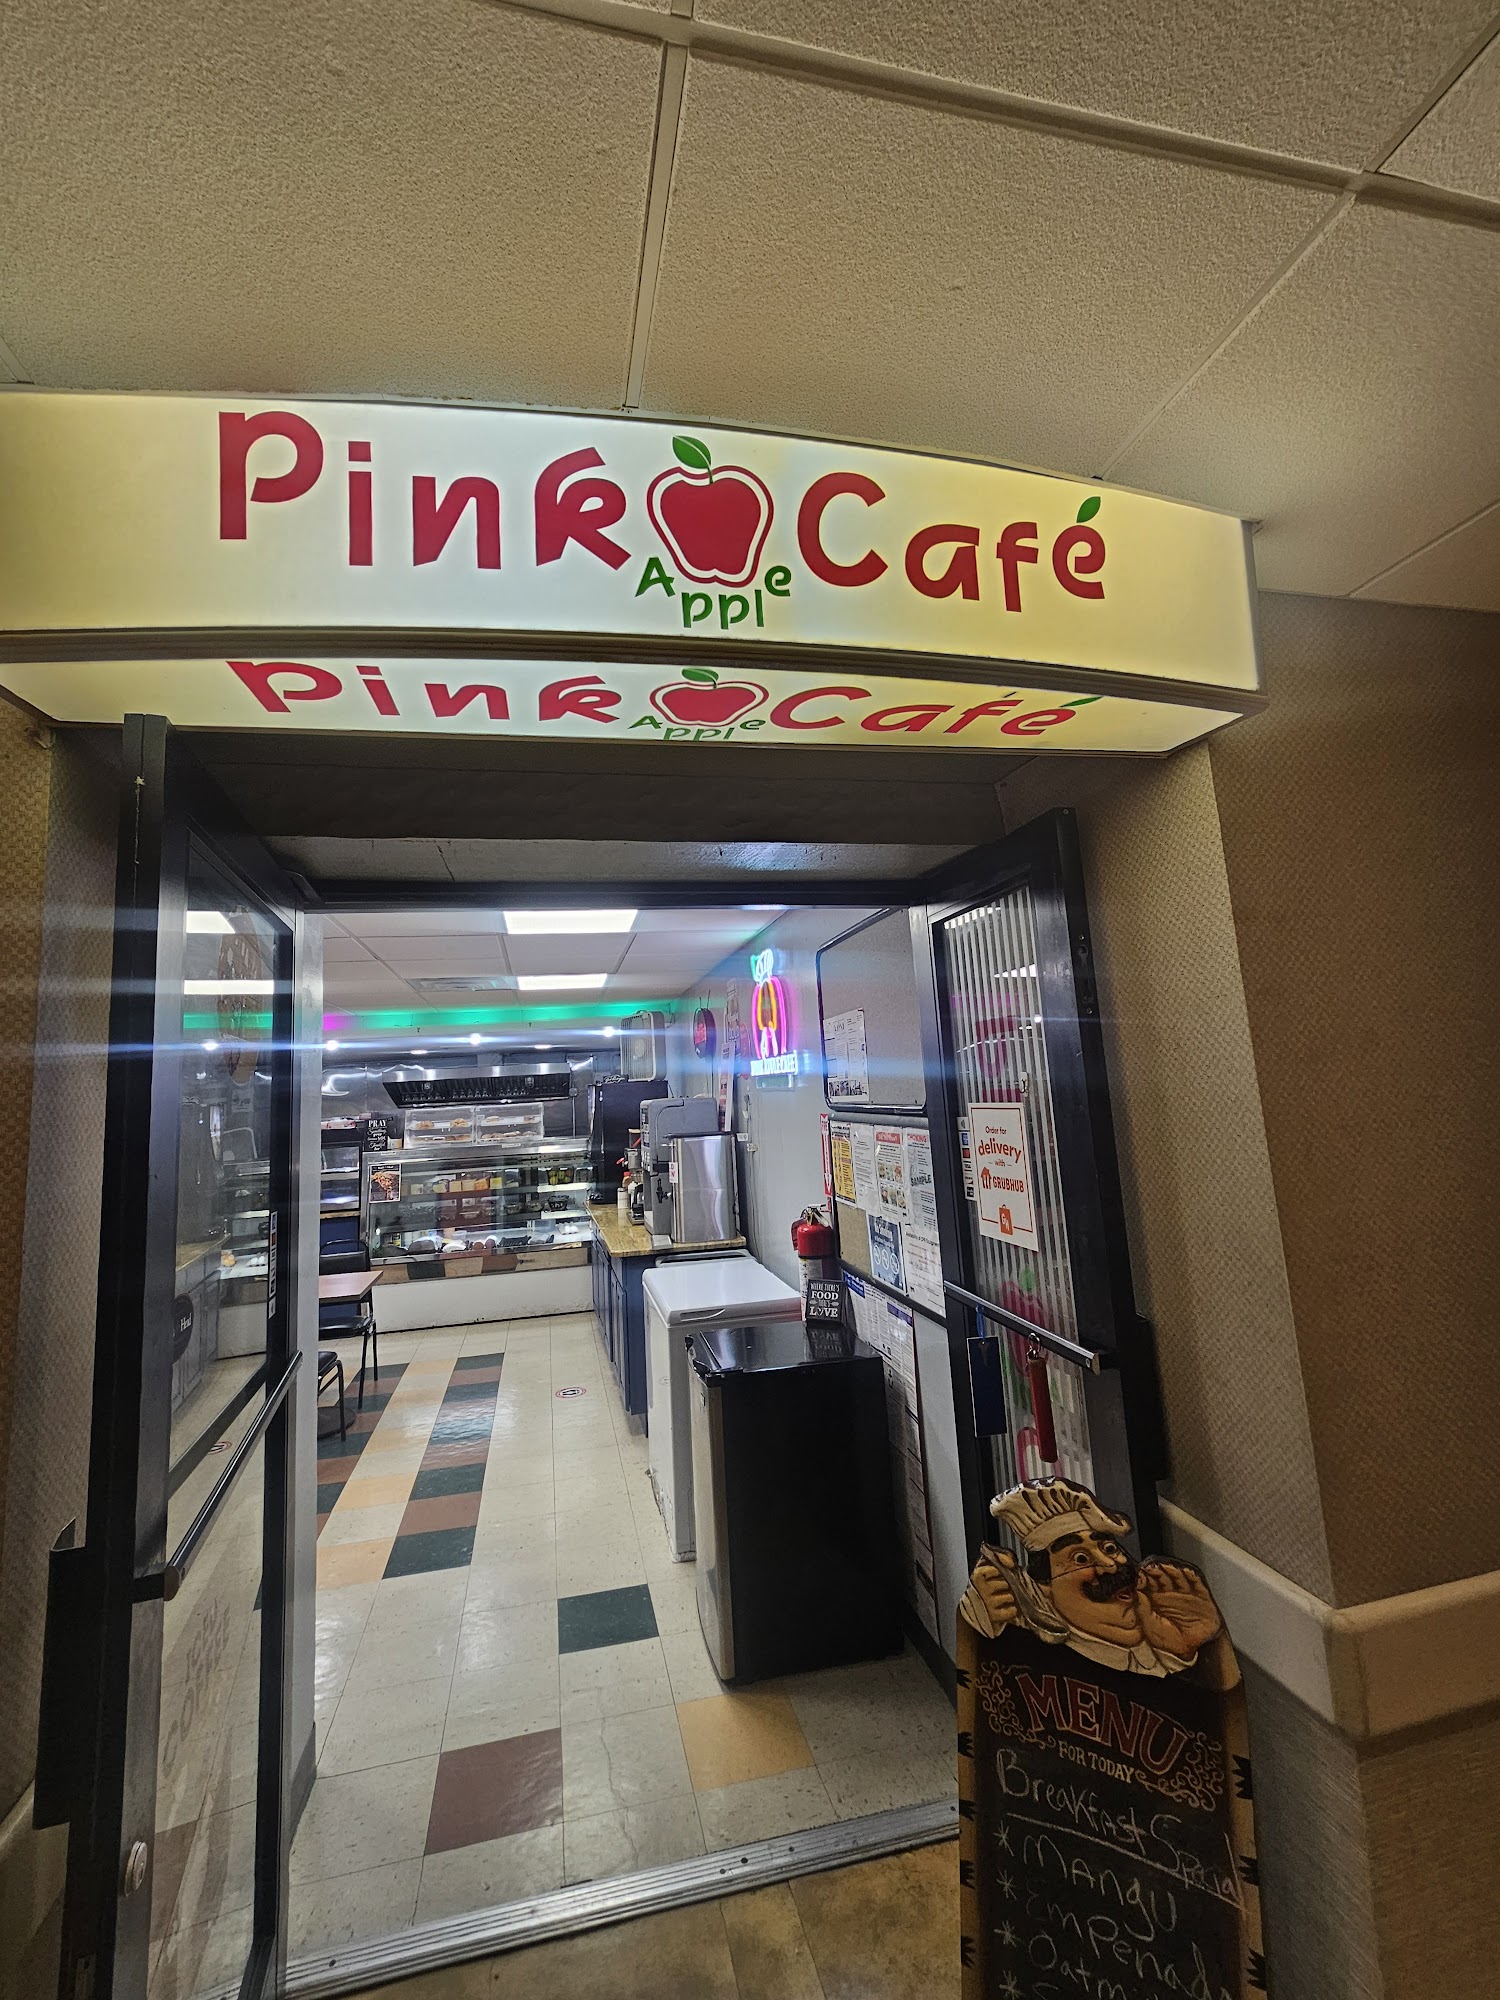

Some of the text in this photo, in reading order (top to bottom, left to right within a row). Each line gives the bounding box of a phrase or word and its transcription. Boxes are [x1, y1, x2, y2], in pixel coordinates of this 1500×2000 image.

[219, 411, 1106, 613] Pink Café
[635, 556, 792, 630] Apple
[226, 661, 1103, 737] Pink Café
[368, 1119, 387, 1128] PRAY
[985, 1125, 1007, 1135] Order for
[978, 1138, 1022, 1164] delivery
[994, 1159, 1006, 1167] with
[992, 1176, 1025, 1193] GRUBHUB
[811, 1290, 839, 1300] FOOD
[1015, 1673, 1190, 1776] MENU
[1058, 1741, 1135, 1784] FOR TODAY
